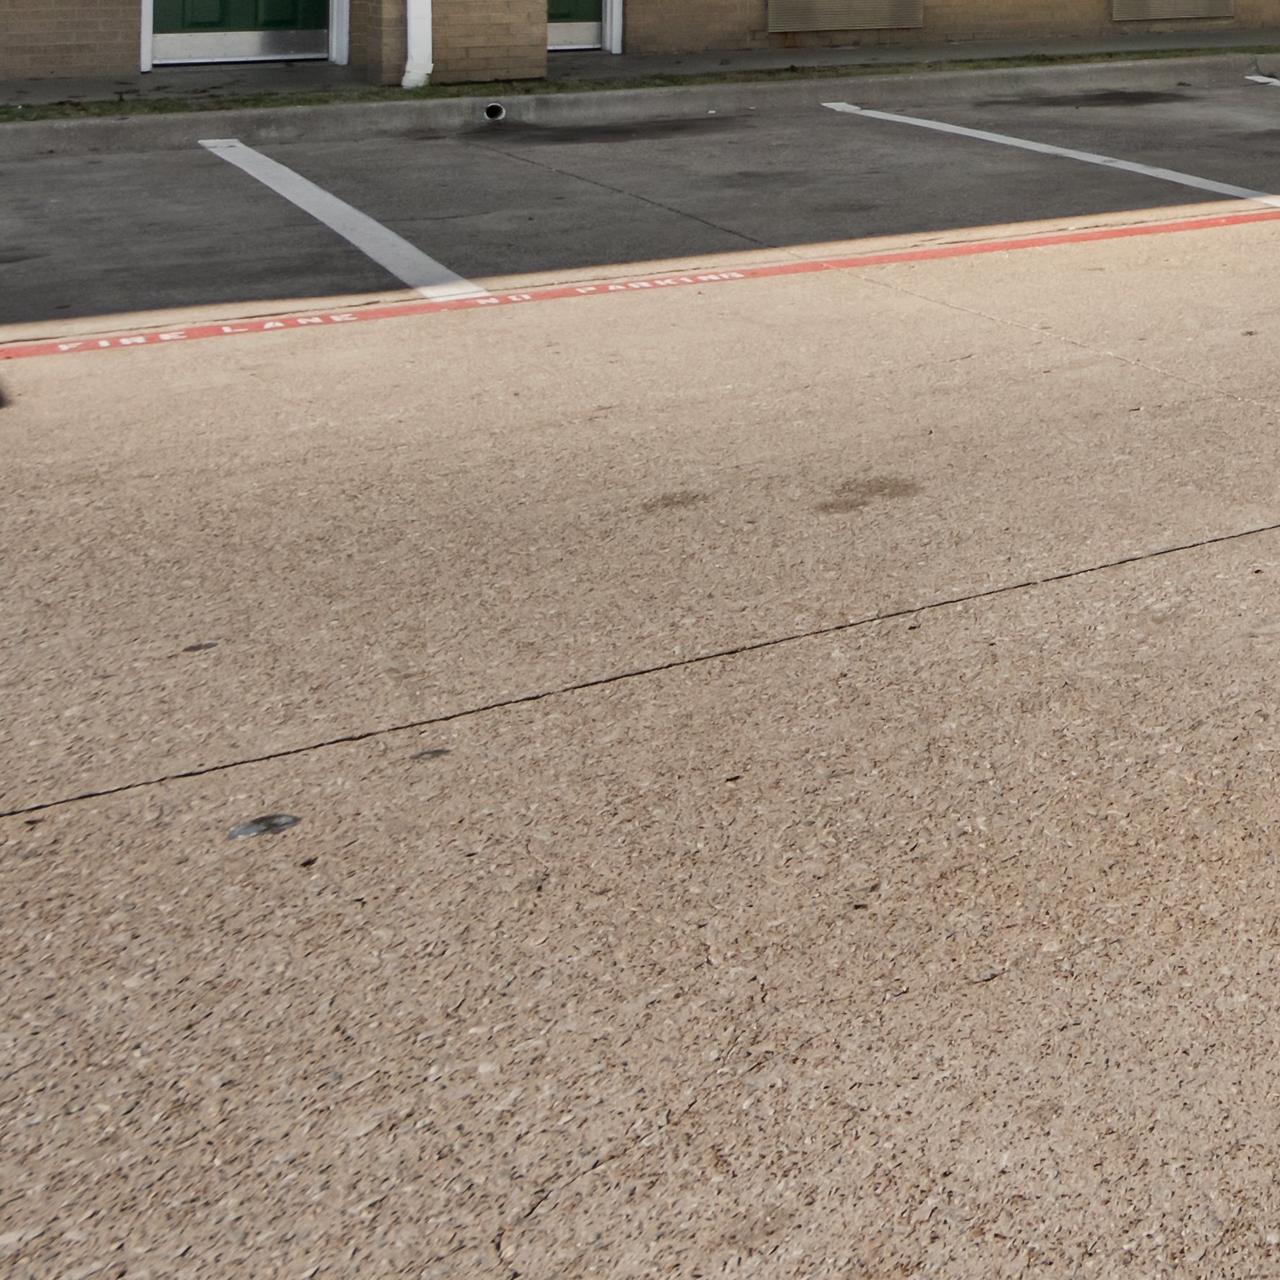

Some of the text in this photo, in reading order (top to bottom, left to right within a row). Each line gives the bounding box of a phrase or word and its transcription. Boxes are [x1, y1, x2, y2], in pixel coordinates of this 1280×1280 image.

[57, 271, 745, 351] FIRE LANE NO PARKING
